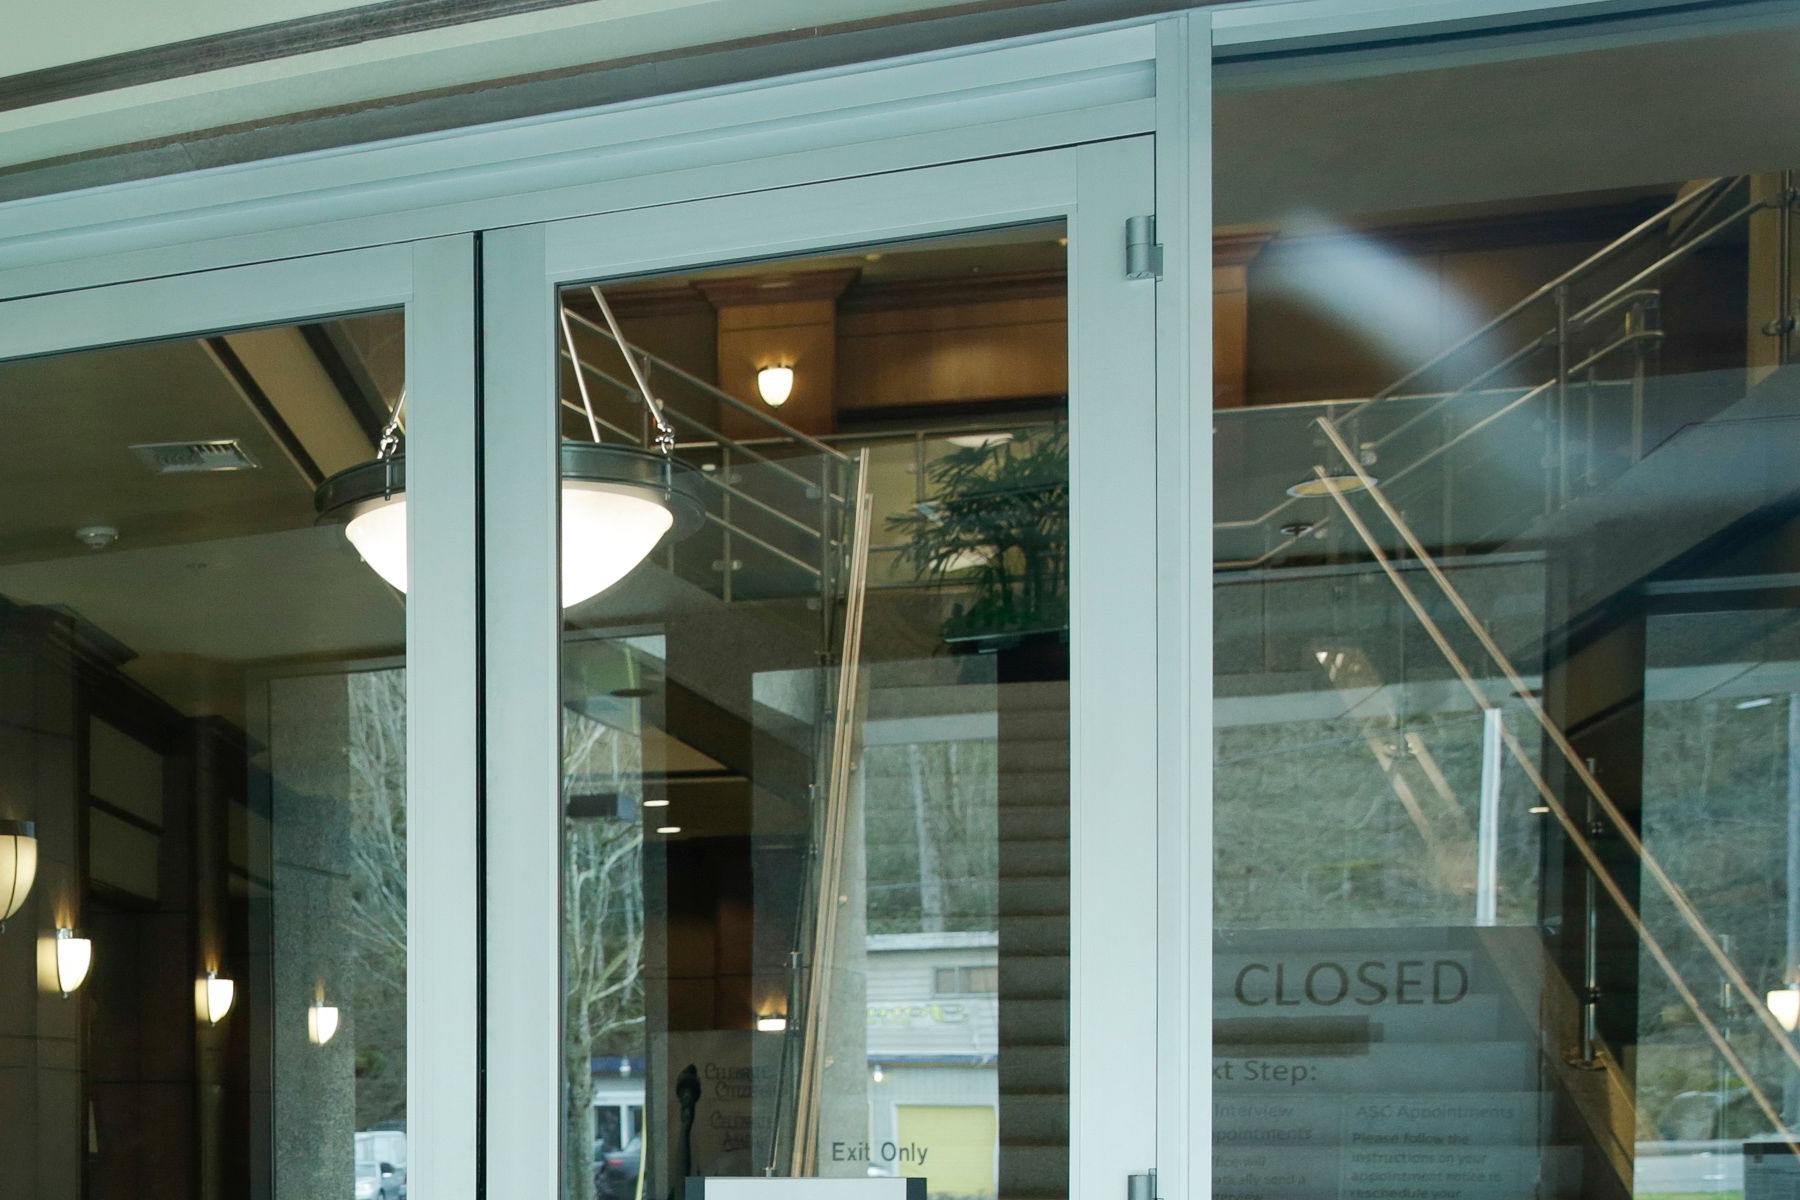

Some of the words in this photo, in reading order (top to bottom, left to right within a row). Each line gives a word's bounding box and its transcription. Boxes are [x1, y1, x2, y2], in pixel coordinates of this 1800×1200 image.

[1234, 960, 1468, 1007] CLOSED
[1244, 1060, 1317, 1086] Step:
[1212, 1128, 1313, 1144] pointments
[832, 1142, 870, 1161] Exit
[881, 1142, 928, 1165] Only
